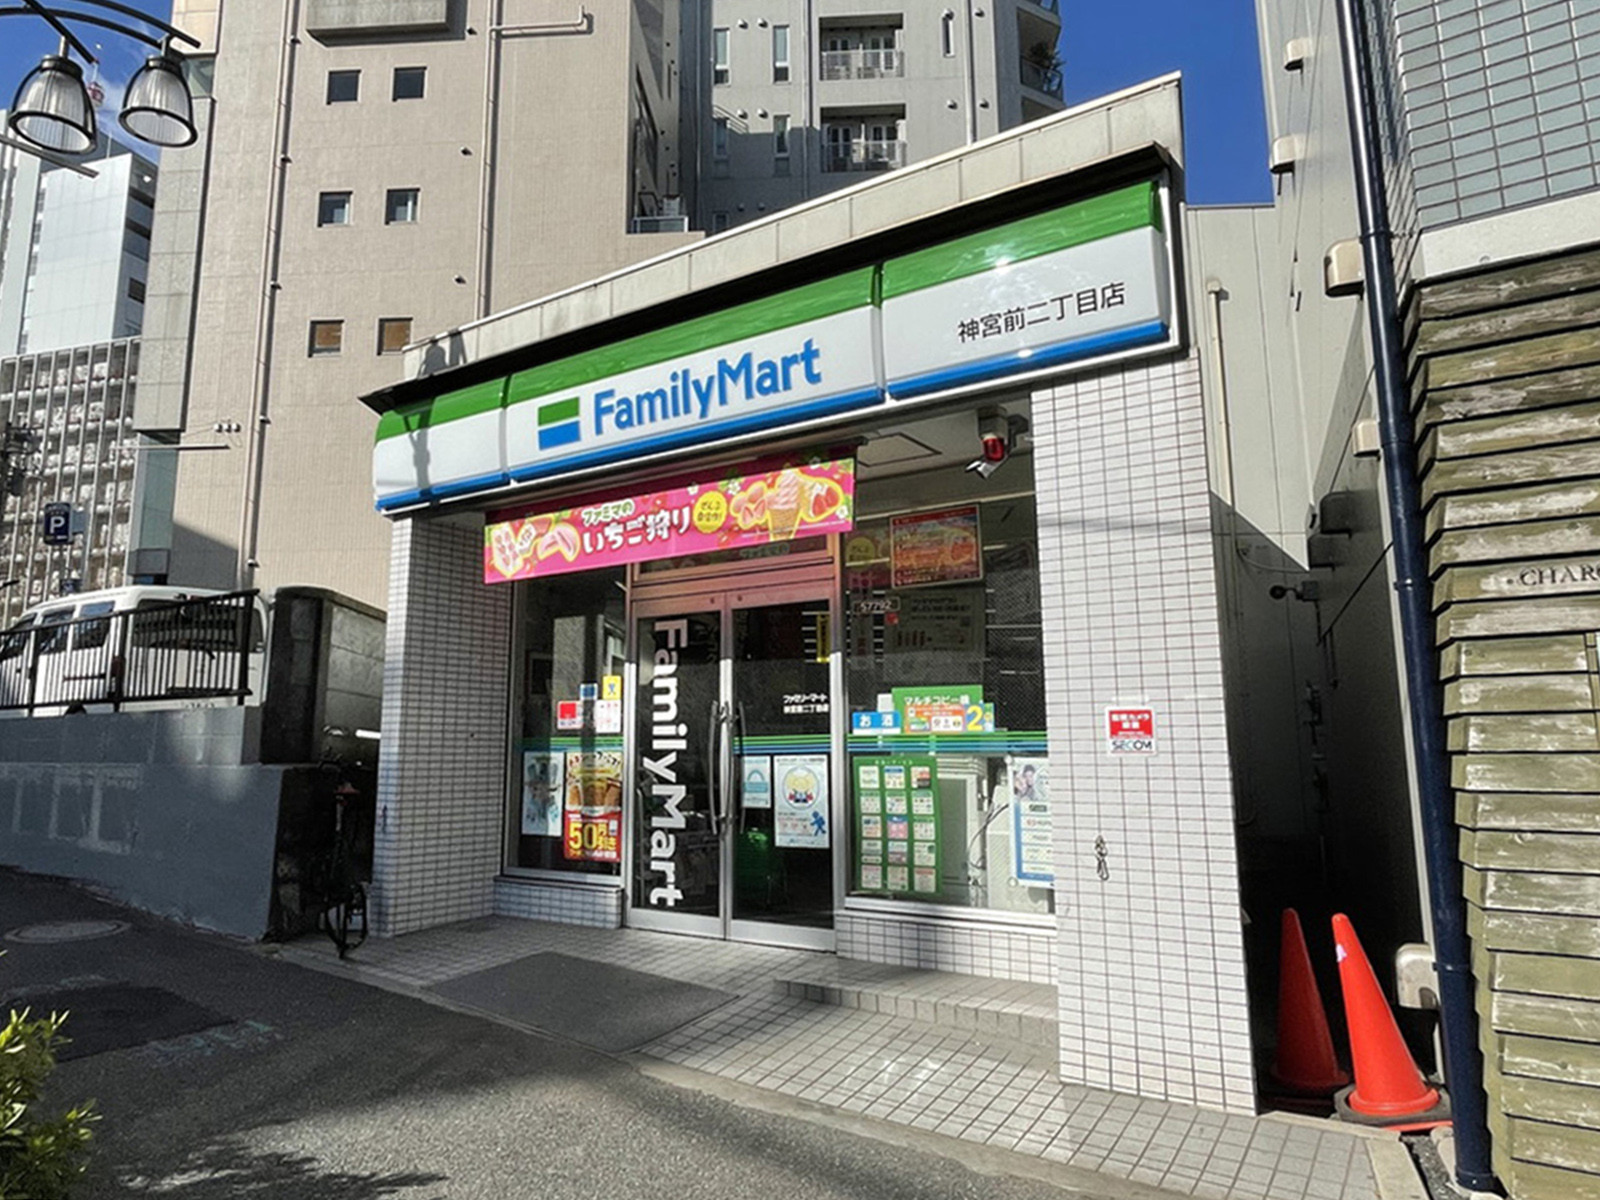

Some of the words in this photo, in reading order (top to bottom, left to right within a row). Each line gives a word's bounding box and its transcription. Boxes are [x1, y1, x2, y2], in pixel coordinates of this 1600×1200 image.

[957, 281, 1126, 344] 神宮前二丁目店
[594, 338, 822, 436] FamilyMart
[49, 516, 65, 534] P
[582, 500, 635, 527] ファミマの
[582, 506, 691, 554] いちご狩り
[1519, 562, 1600, 586] CHAR
[642, 618, 688, 908] FamilyMart
